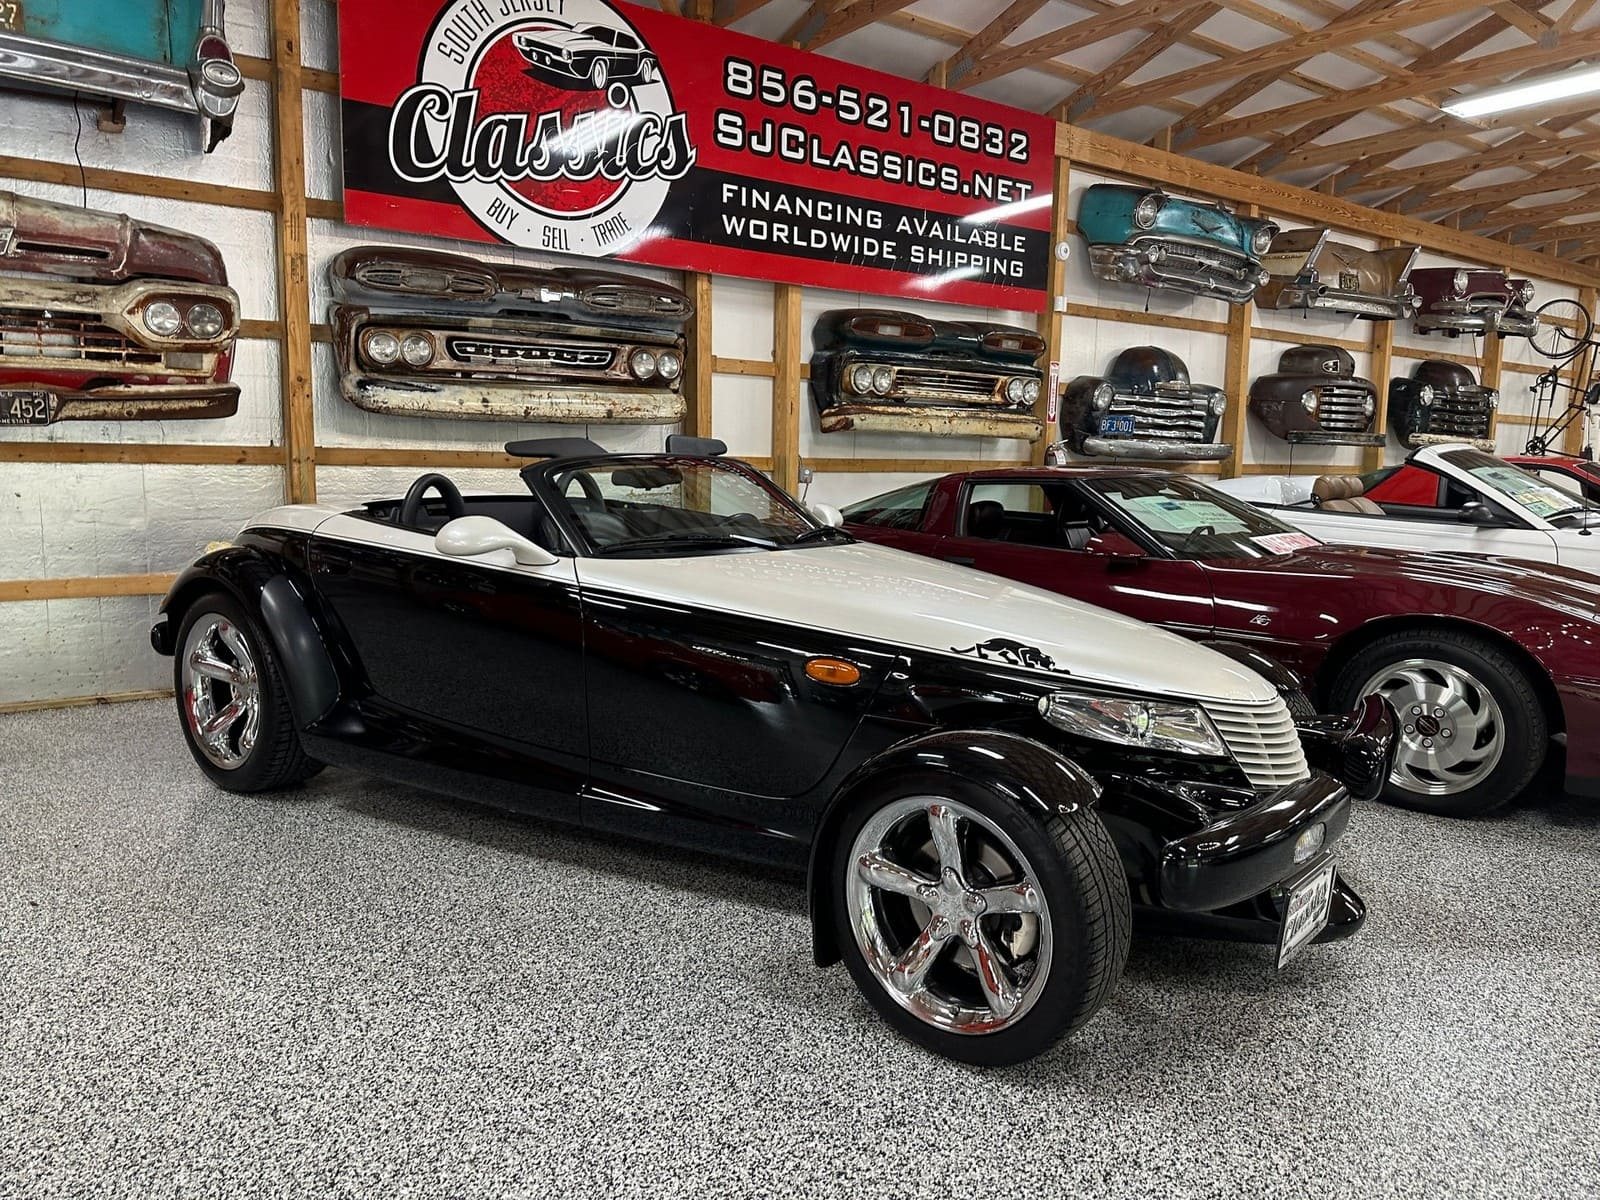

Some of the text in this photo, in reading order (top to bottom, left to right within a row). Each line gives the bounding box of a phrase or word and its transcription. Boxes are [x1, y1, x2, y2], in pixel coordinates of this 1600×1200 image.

[437, 0, 495, 65] SOUTH
[388, 83, 699, 183] Classics
[725, 58, 1030, 162] 856-521-0832
[486, 196, 633, 251] BUY SELL TRADE
[721, 213, 1024, 278] WORLDWIDE SHIPPING
[722, 183, 1026, 253] FINANCING AVAILABLE
[10, 398, 46, 418] 452
